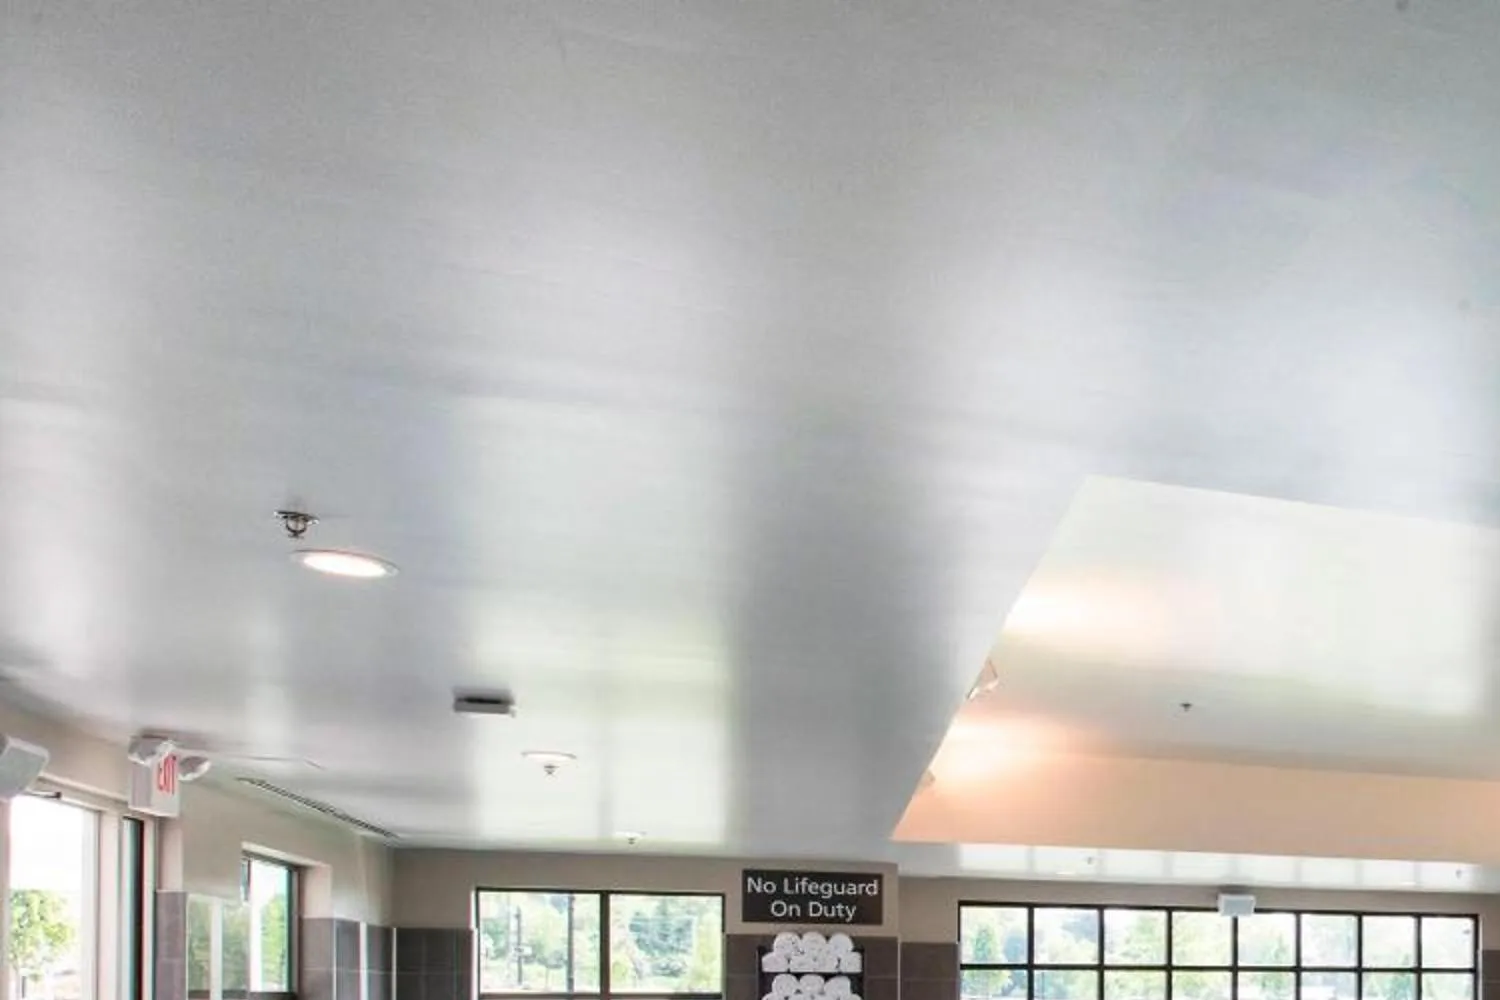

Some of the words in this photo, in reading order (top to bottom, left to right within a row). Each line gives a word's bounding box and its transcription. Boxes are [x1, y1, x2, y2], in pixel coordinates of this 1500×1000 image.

[747, 877, 777, 893] No
[783, 877, 878, 899] Lifeguard
[770, 900, 800, 917] On
[808, 901, 857, 922] Duty
